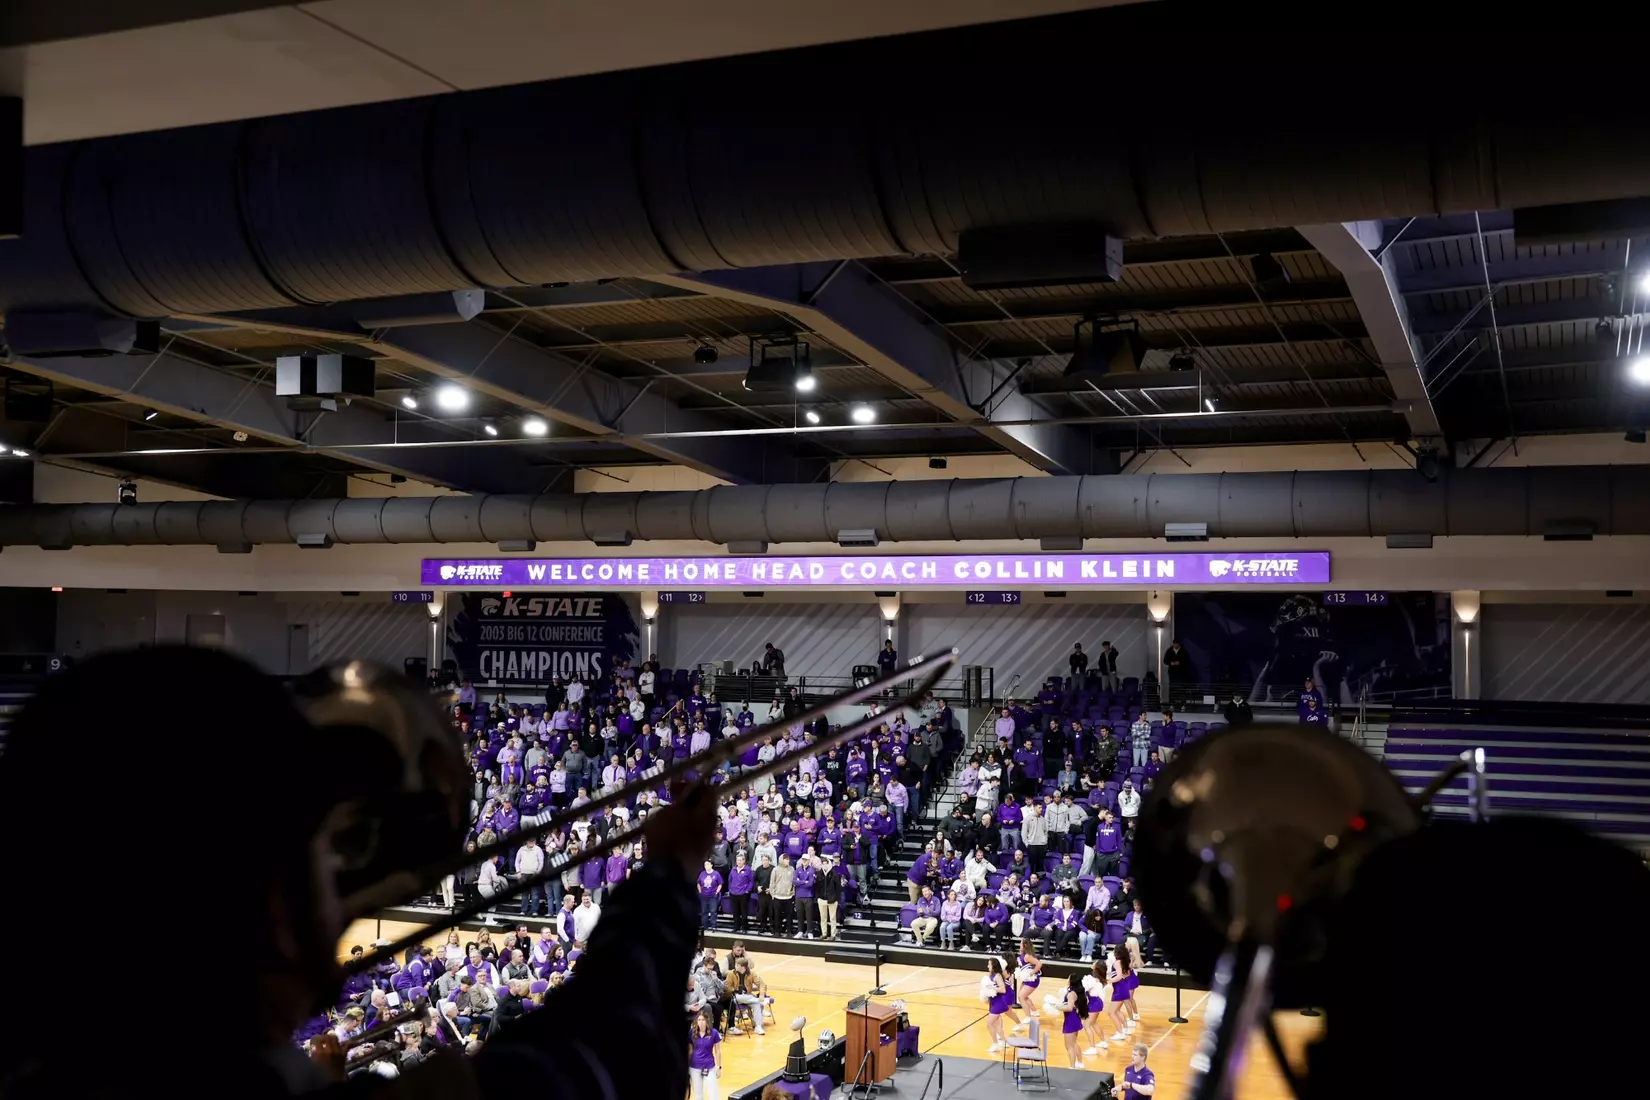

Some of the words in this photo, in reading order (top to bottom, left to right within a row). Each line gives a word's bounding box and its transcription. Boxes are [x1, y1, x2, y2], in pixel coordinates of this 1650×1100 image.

[456, 565, 503, 576] K-STATE
[527, 563, 650, 581] WELCOME
[664, 563, 737, 581] HOME
[751, 562, 825, 580] HEAD
[840, 561, 937, 580] COACH
[953, 560, 1064, 579] COLLIN
[1080, 559, 1175, 579] KLEIN
[1231, 559, 1299, 572] K-STATE
[398, 592, 408, 601] 10
[420, 592, 428, 601] 11
[665, 593, 673, 602] 11
[688, 593, 698, 602] 12
[974, 593, 985, 603] 12
[1001, 593, 1012, 603] 13
[1334, 592, 1346, 603] 13
[1365, 592, 1378, 603] 14
[502, 597, 604, 617] K-STATE
[480, 625, 505, 641] 2003
[507, 625, 524, 641] BIG
[527, 625, 538, 641] 12
[540, 626, 604, 642] CONFERENCE
[50, 658, 61, 670] 9
[479, 650, 603, 681] CHAMPIONS
